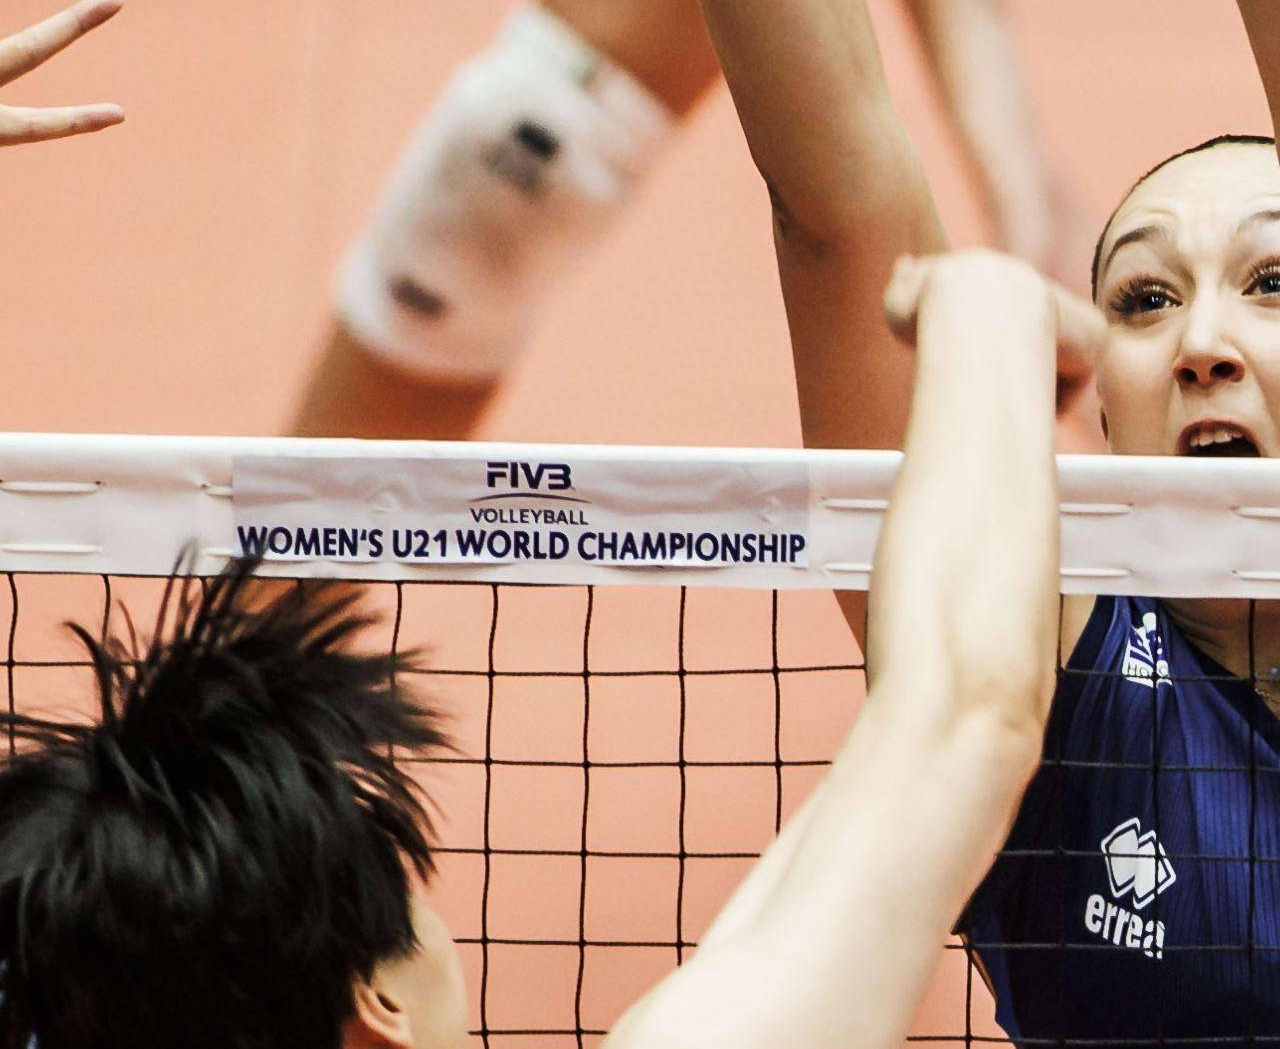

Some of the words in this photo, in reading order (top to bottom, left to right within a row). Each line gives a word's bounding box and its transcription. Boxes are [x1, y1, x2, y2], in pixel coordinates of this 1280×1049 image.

[486, 461, 572, 491] FIVB
[468, 507, 589, 526] VOLLEYBALL
[236, 525, 384, 559] WOMEN'S
[392, 529, 448, 558] U21
[455, 529, 570, 560] WORLD
[577, 531, 806, 563] CHAMPIONSHIP
